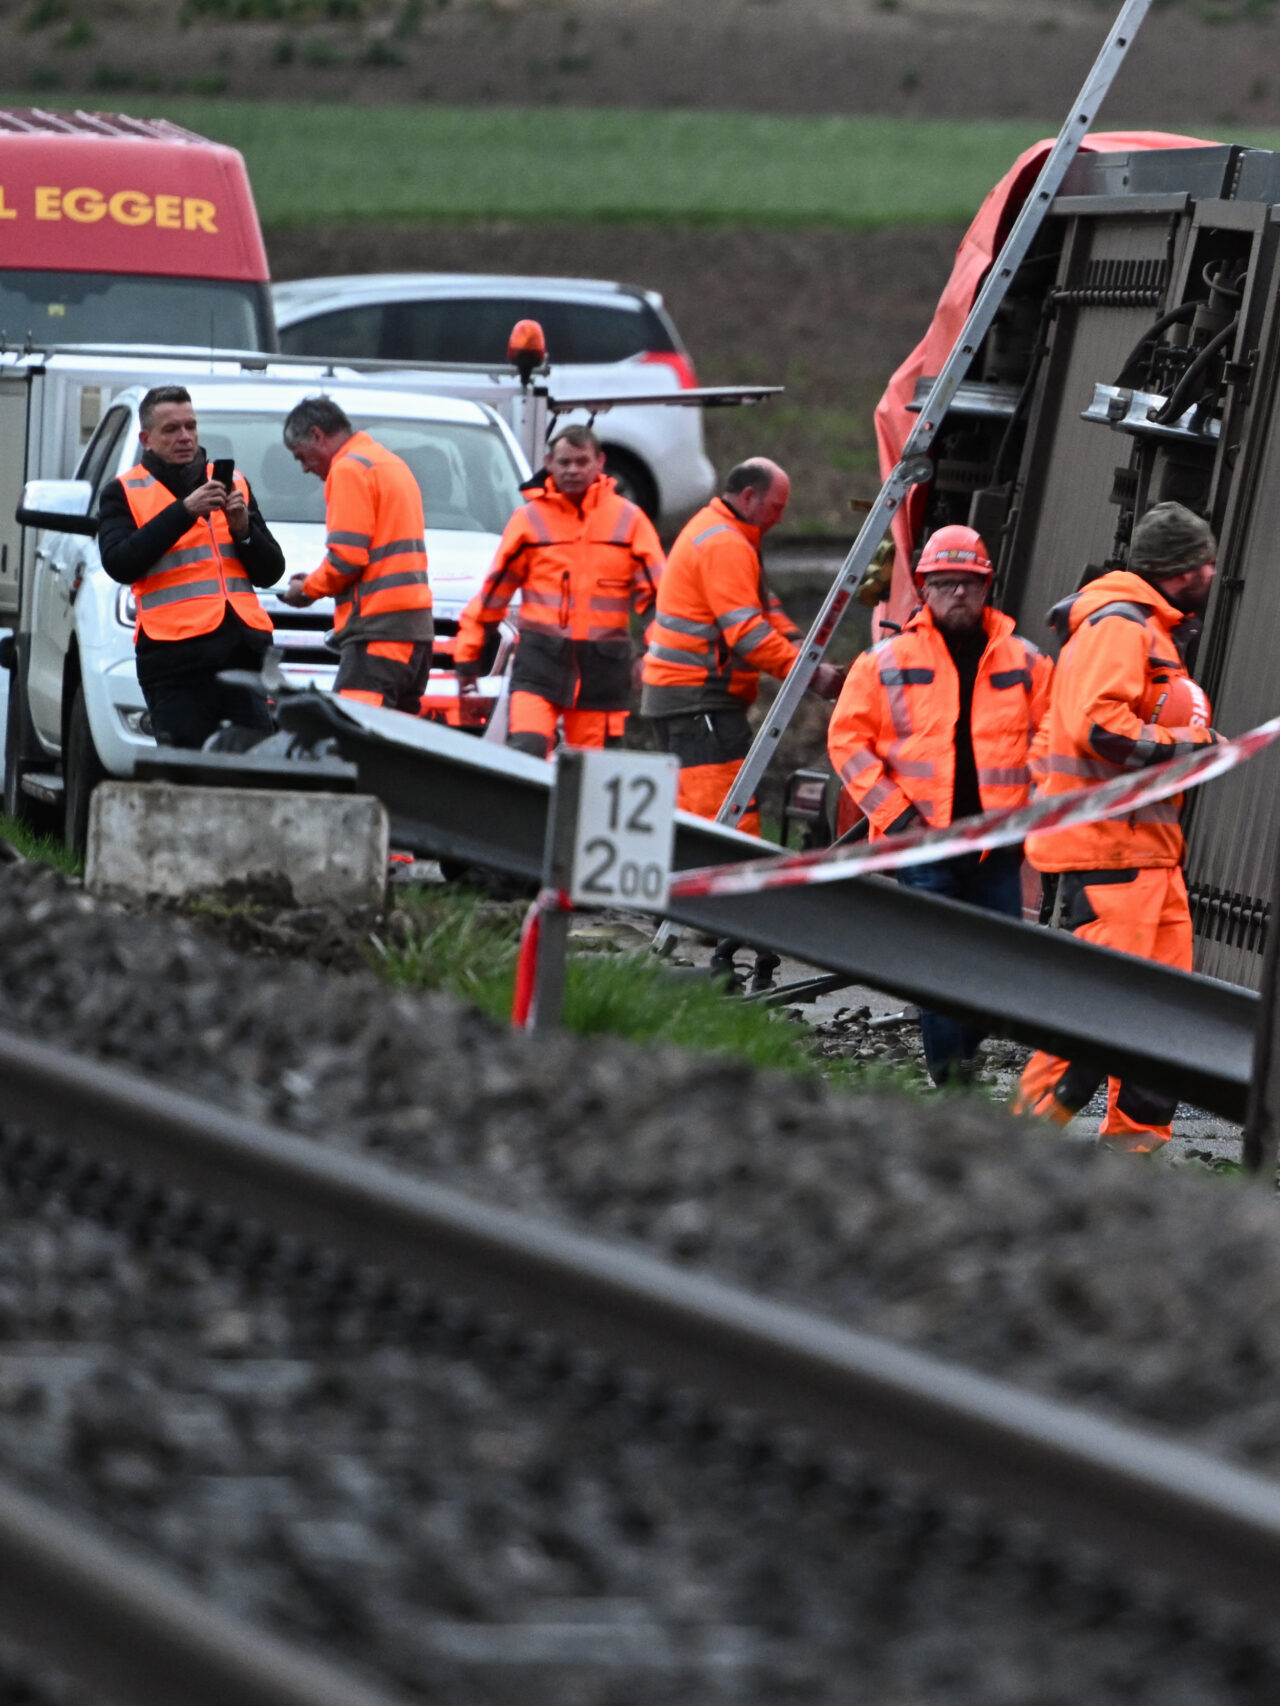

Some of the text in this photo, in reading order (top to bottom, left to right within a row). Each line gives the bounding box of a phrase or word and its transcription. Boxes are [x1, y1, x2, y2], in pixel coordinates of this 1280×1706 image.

[35, 186, 219, 234] EGGER
[604, 774, 658, 833] 12
[581, 836, 664, 901] 200
